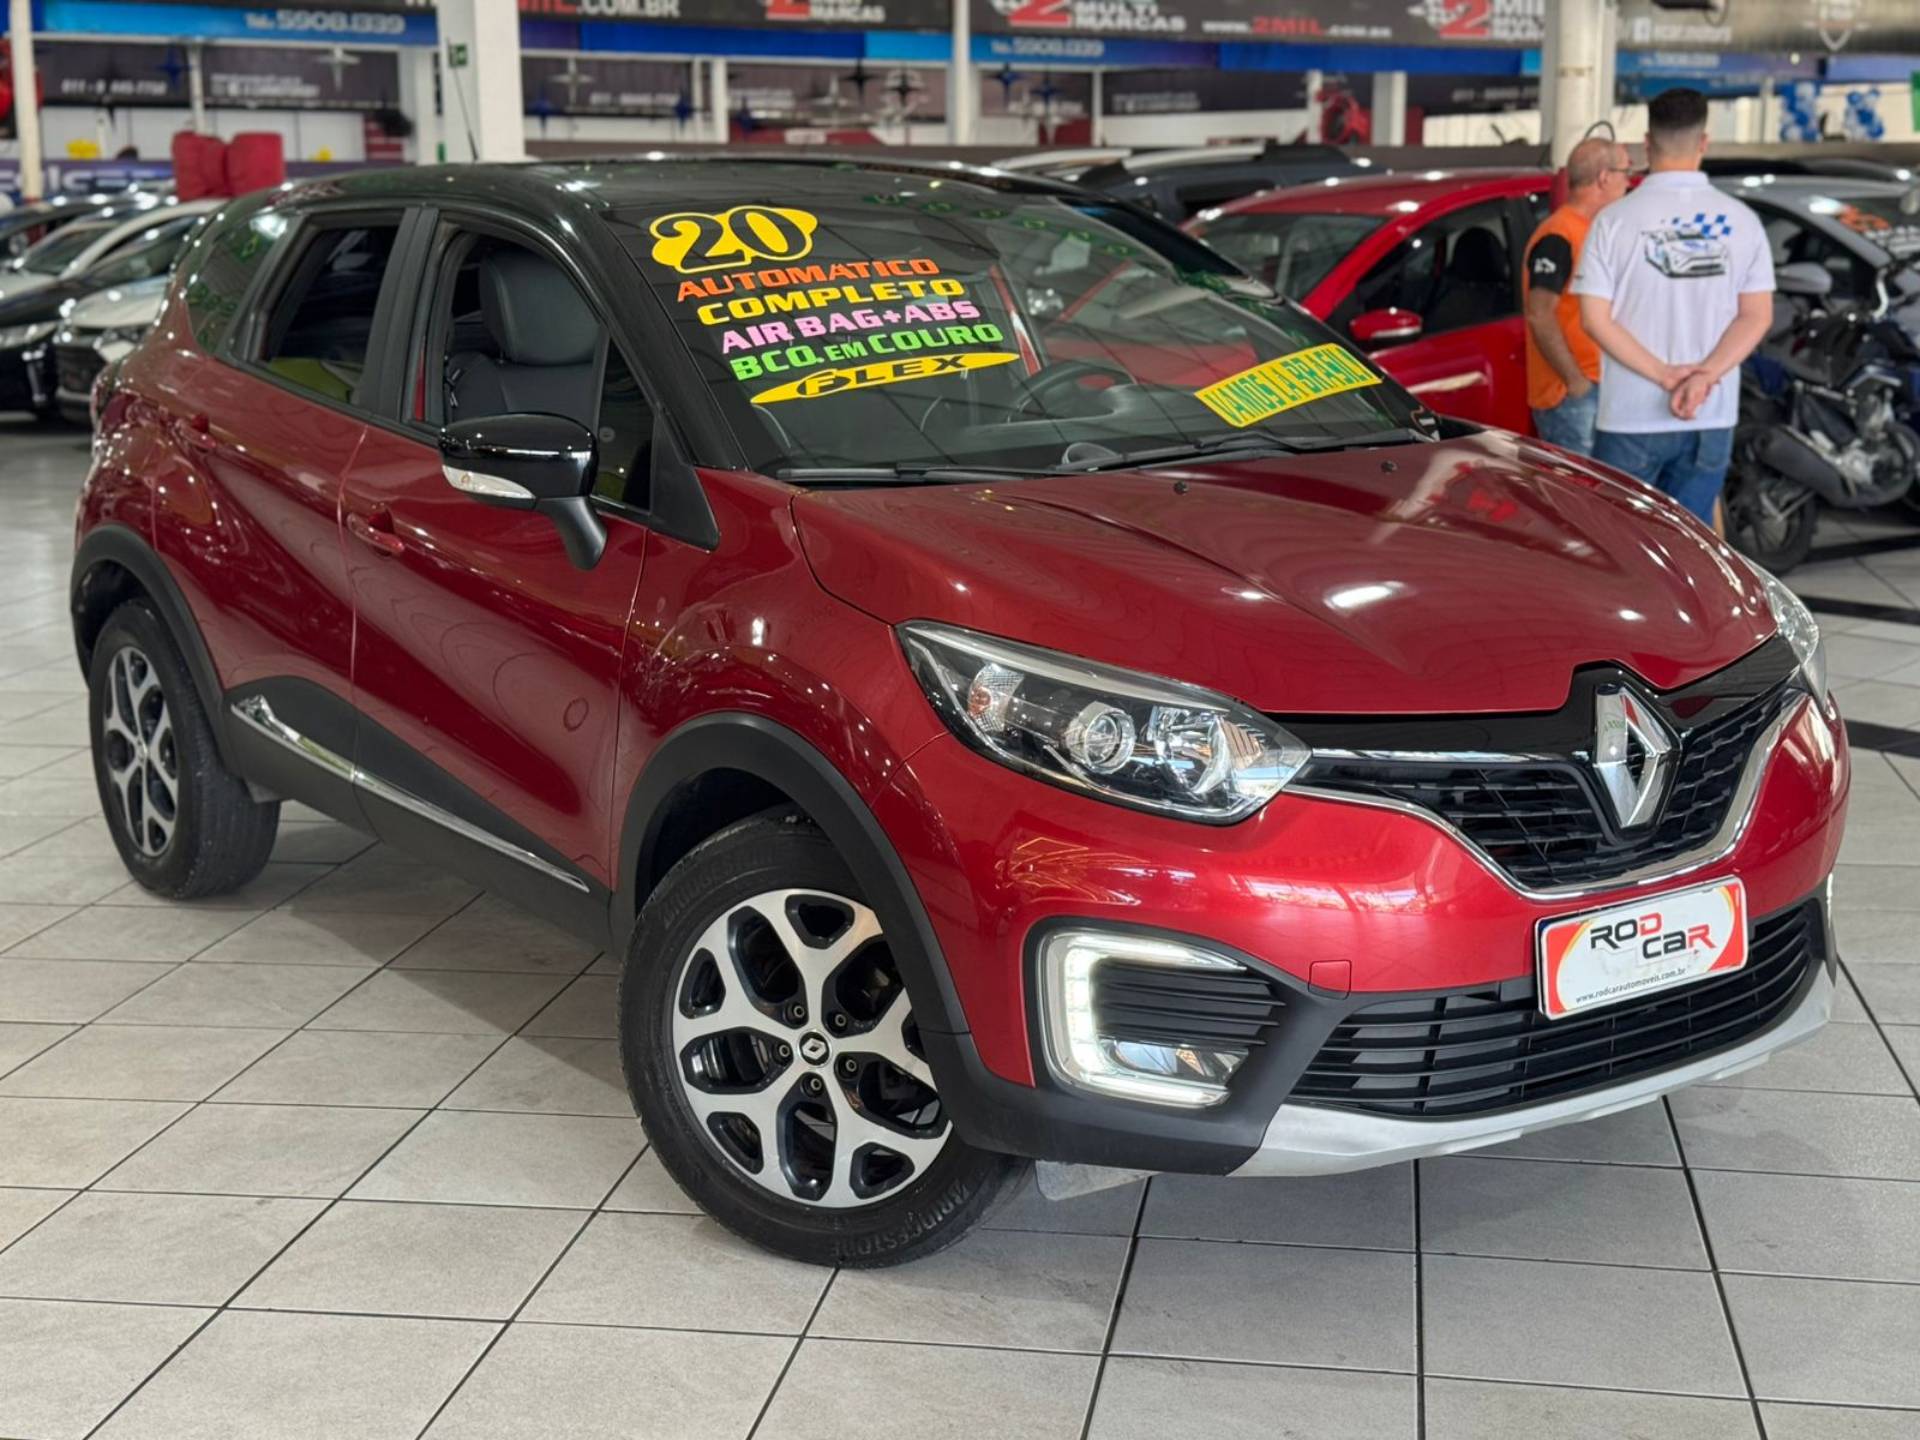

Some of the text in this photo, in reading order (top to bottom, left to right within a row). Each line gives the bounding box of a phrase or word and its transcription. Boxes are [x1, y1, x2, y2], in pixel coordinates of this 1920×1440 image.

[650, 205, 817, 274] 20
[697, 278, 966, 326] COMPLETO
[722, 300, 981, 354] AIR BAG+ABS
[823, 341, 869, 362] EM
[866, 323, 1004, 354] COURO
[797, 354, 966, 397] FLEX
[1589, 912, 1662, 950] ROD
[1575, 967, 1687, 1003] www.rodcarautomoveis.com.br
